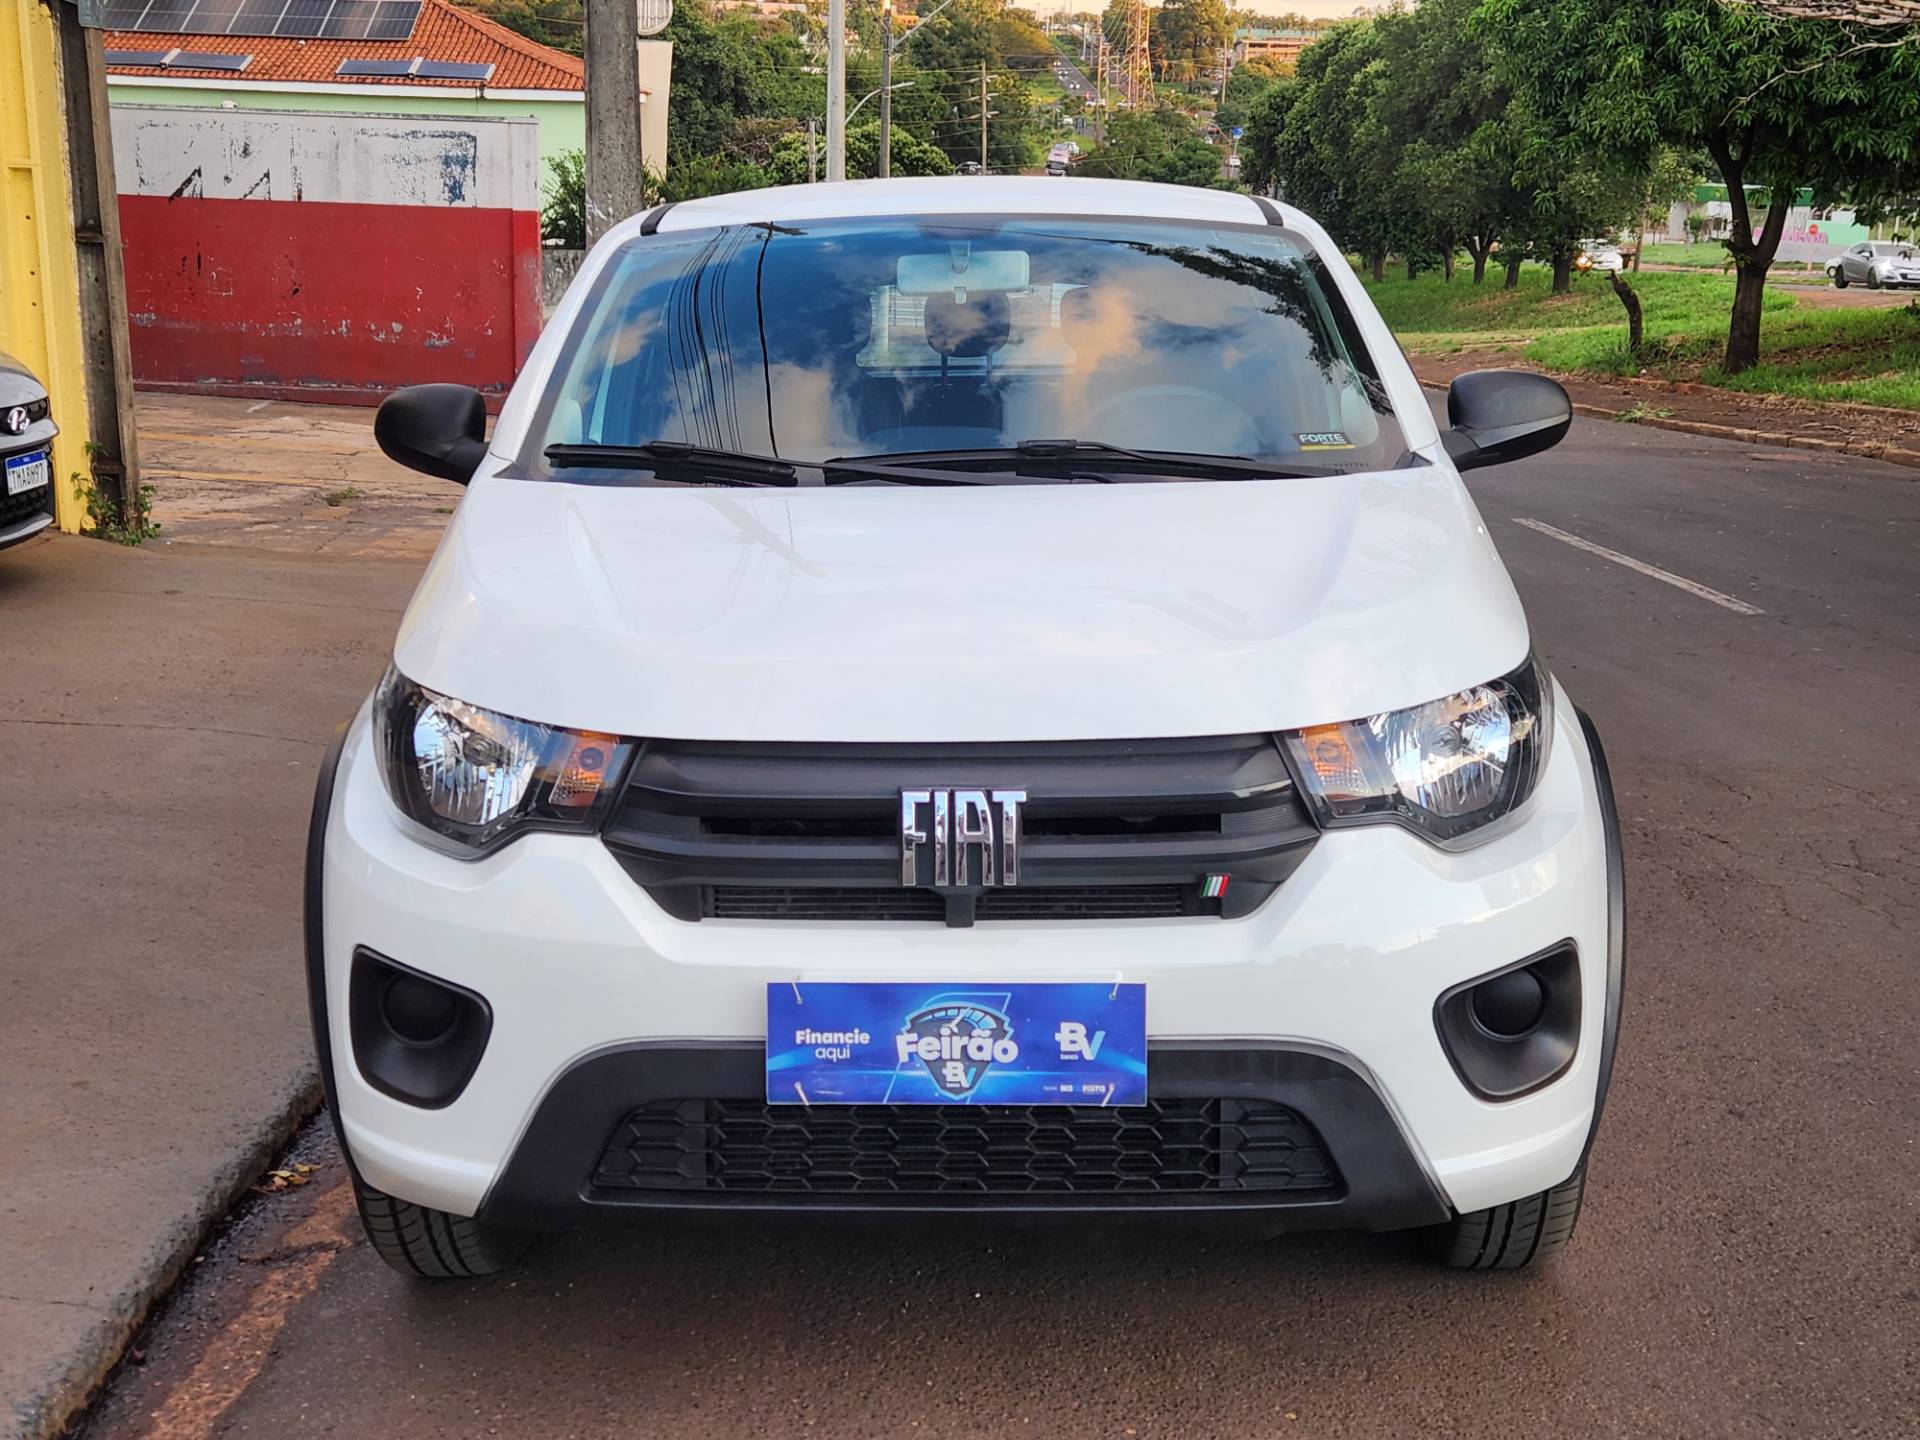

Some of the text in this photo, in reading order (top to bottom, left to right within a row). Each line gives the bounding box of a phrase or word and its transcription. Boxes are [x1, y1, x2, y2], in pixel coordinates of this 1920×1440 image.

[1299, 433, 1345, 443] FORTE
[901, 790, 1027, 887] FIAT
[795, 1028, 870, 1045] Financie
[896, 1028, 1019, 1063] Feirão
[1059, 1021, 1106, 1061] BV
[815, 1044, 850, 1062] aqui
